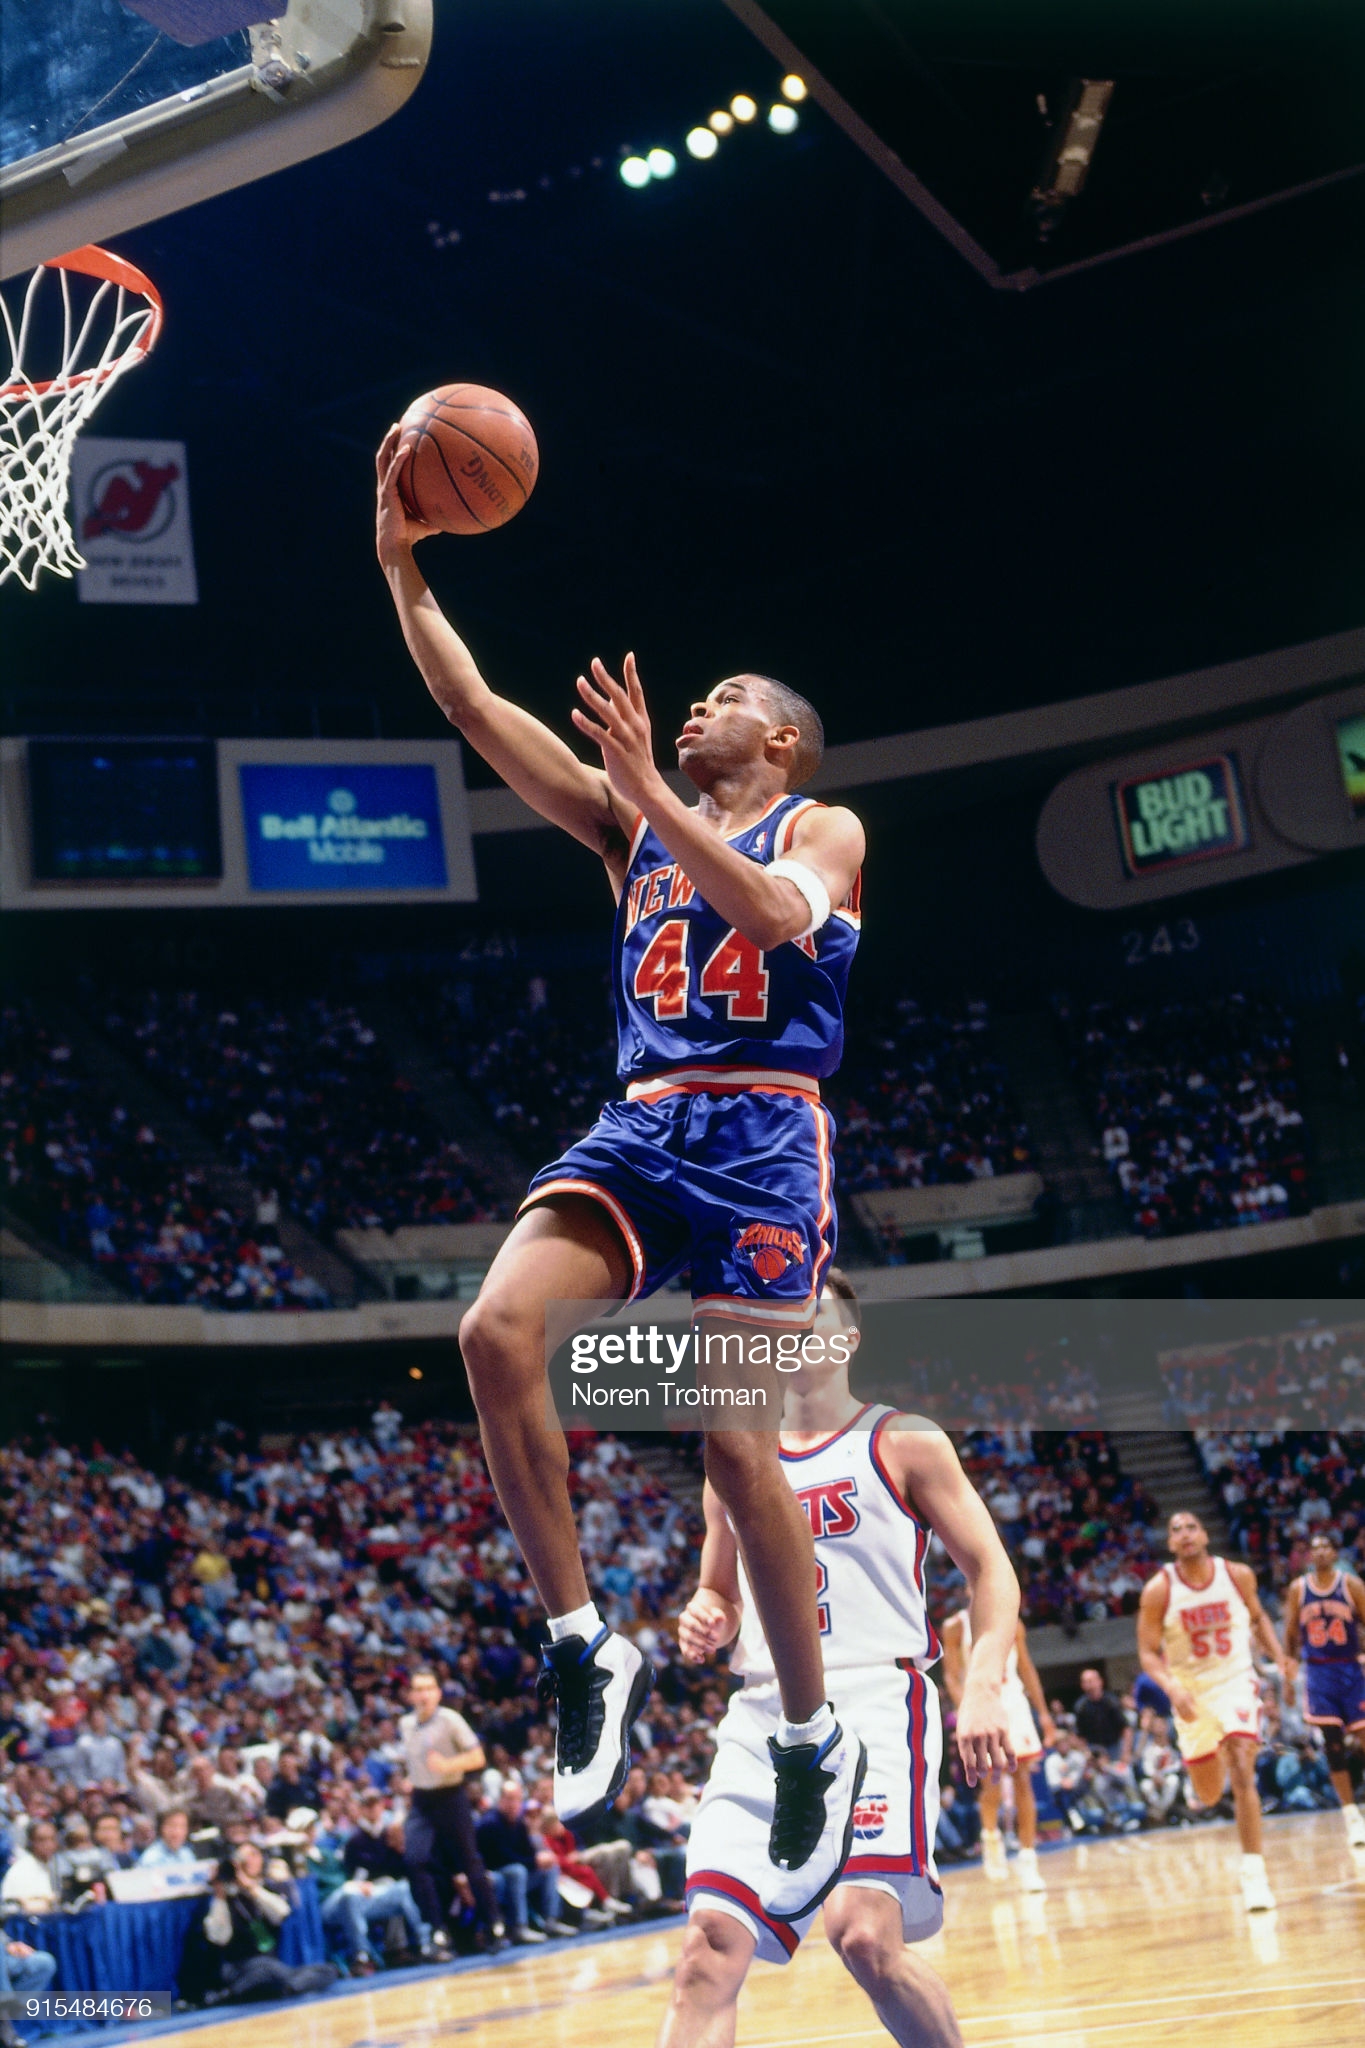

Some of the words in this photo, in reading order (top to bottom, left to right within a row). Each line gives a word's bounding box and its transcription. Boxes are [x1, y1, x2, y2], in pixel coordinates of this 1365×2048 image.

[1136, 770, 1213, 820] BUD
[261, 814, 317, 840] Bell
[319, 812, 428, 840] Atlantic
[1130, 799, 1228, 857] LIGHT
[624, 863, 697, 943] NEW
[1122, 918, 1199, 966] 243
[634, 919, 770, 1022] 44
[736, 1222, 805, 1265] KNICKS
[795, 1476, 861, 1541] TS
[1190, 1626, 1231, 1659] 55
